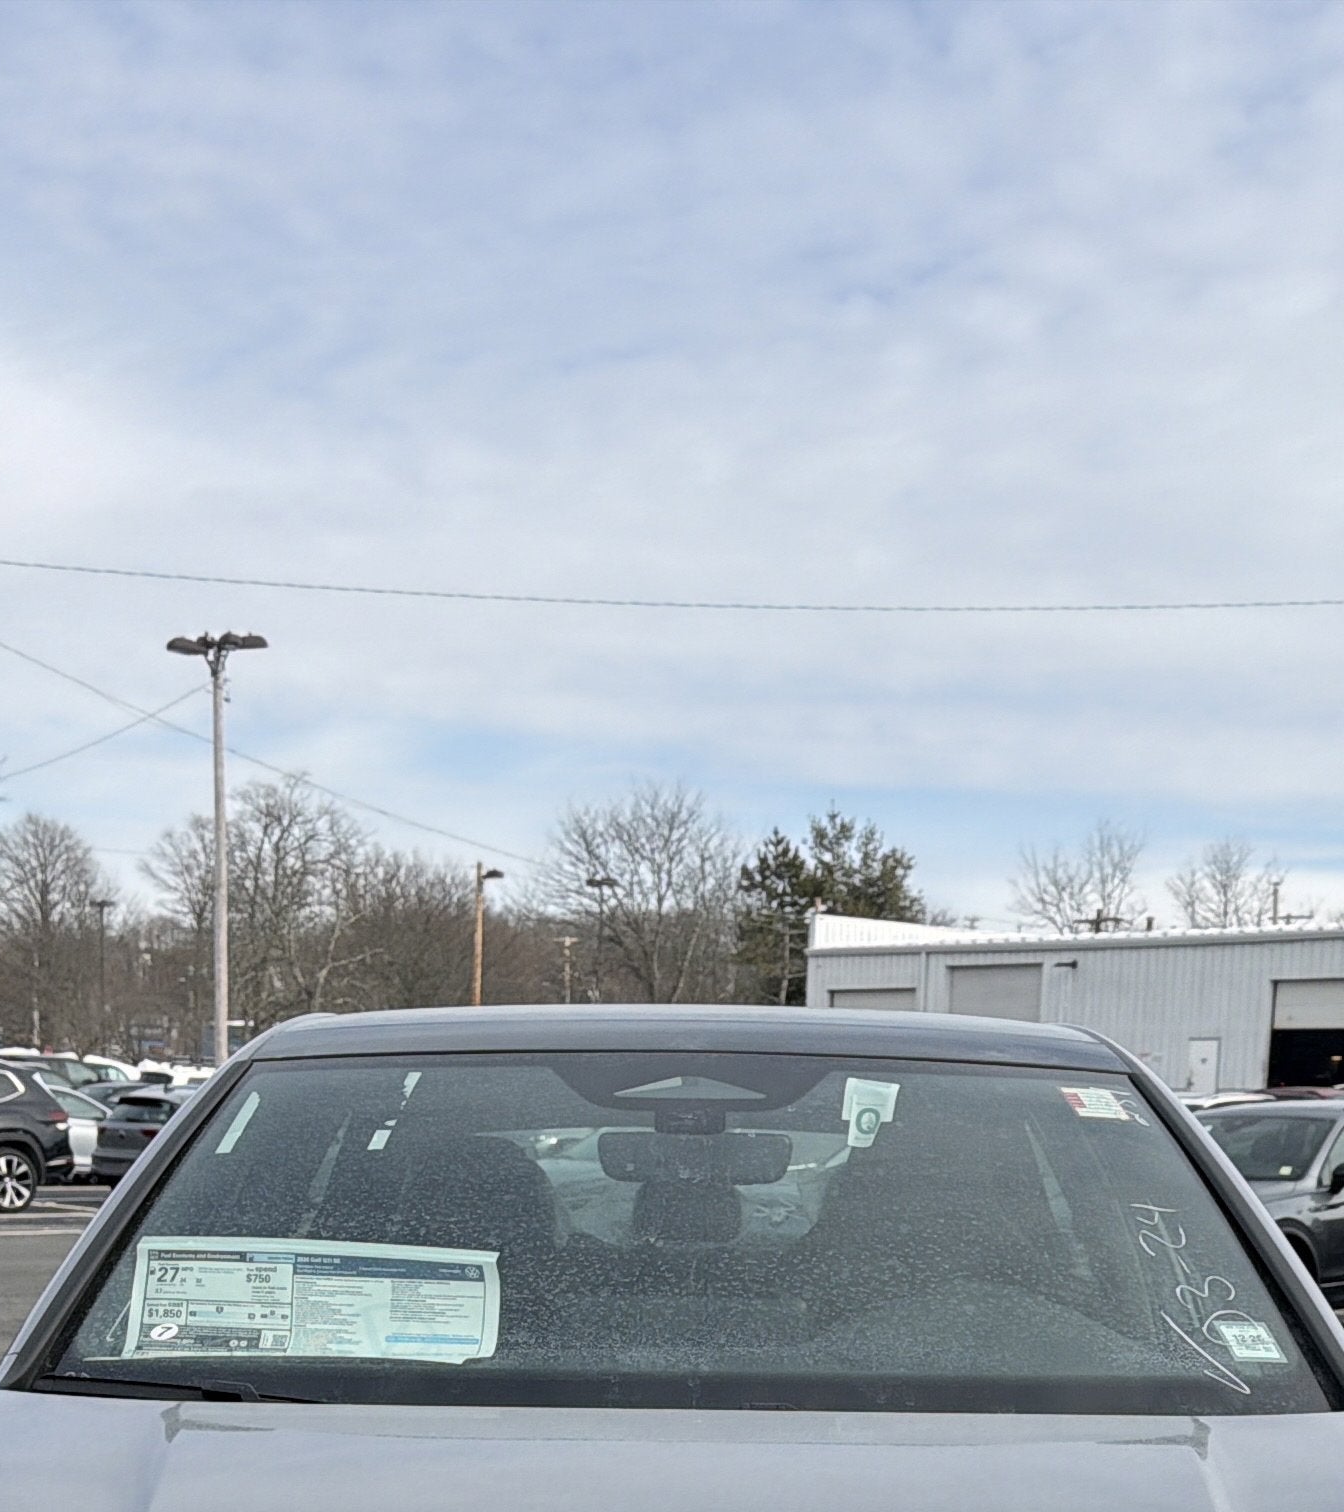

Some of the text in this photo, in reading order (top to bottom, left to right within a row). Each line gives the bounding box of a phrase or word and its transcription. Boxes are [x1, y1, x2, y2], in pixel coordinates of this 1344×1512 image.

[157, 1266, 180, 1283] 27
[246, 1273, 271, 1284] $750
[147, 1308, 183, 1319] $1,850
